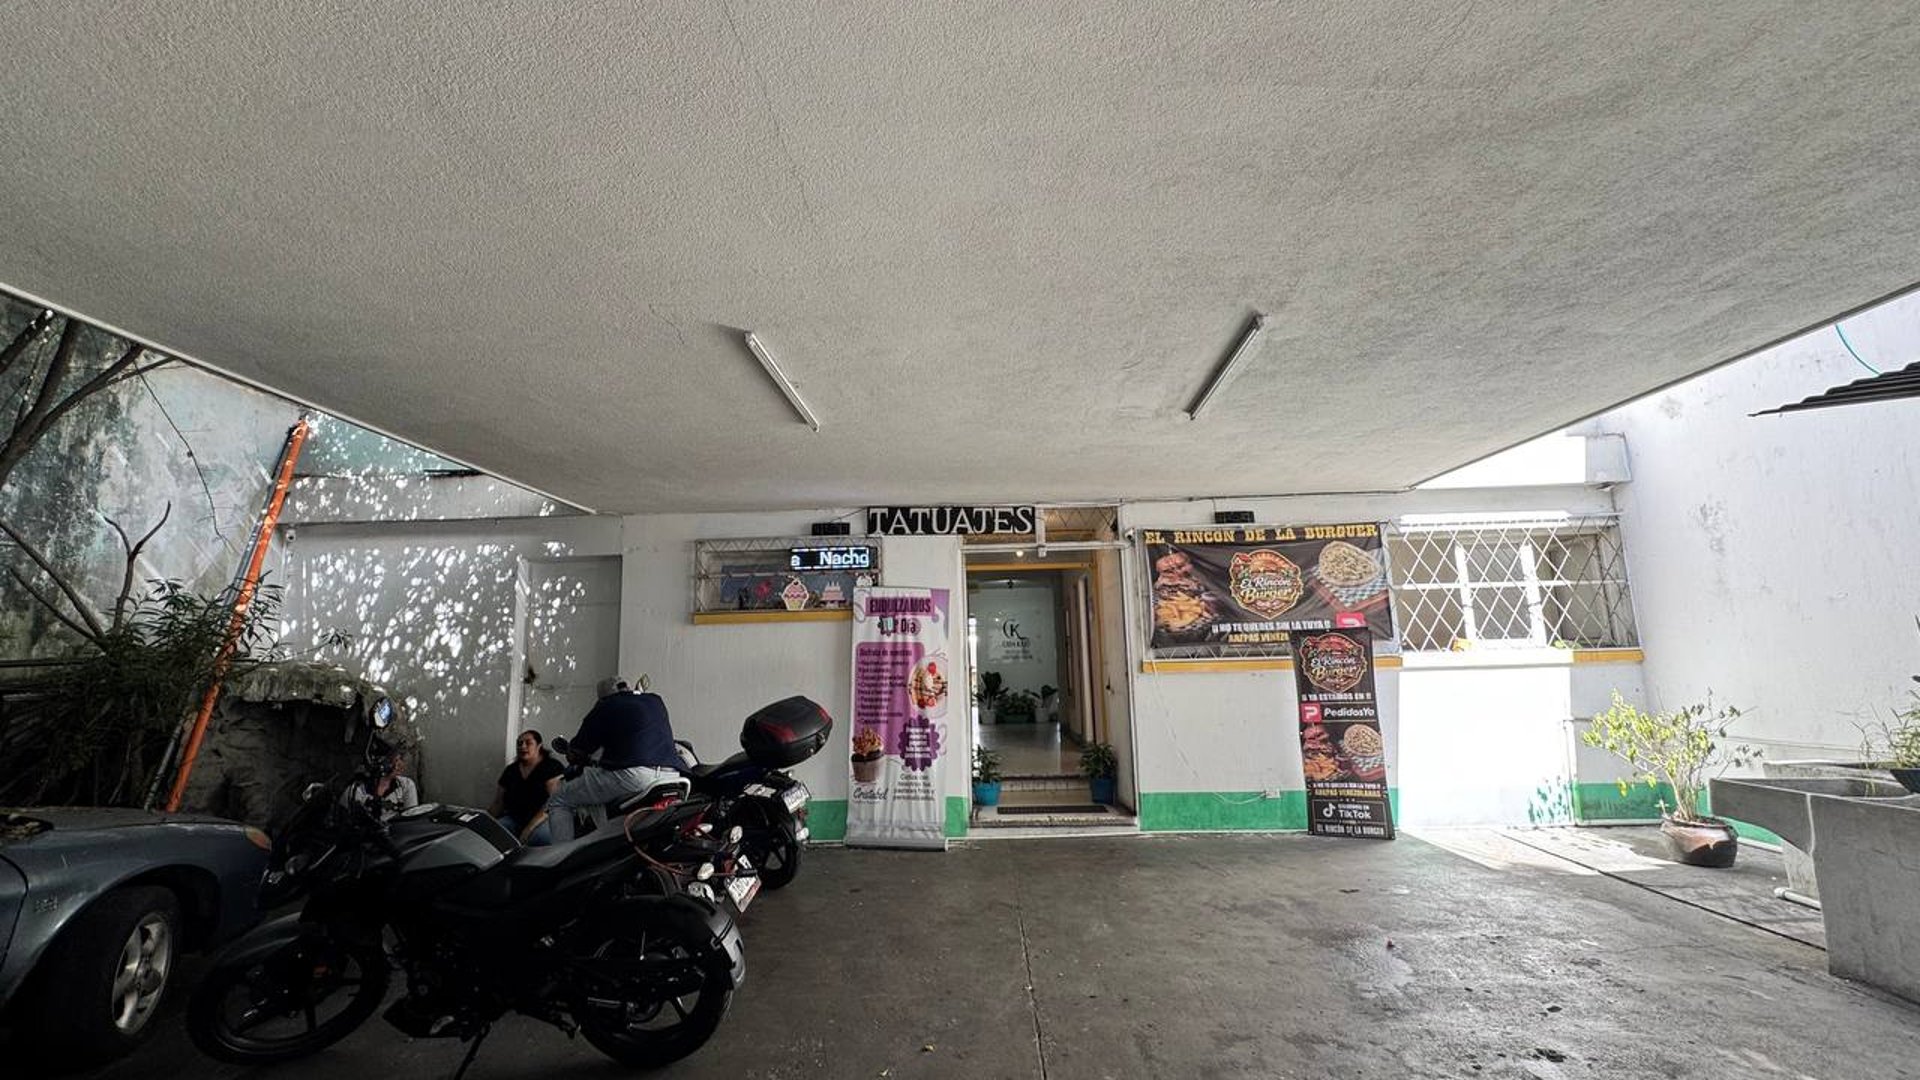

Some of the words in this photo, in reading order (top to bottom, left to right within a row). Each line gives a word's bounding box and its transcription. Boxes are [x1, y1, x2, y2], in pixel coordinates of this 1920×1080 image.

[869, 507, 1033, 534] TATUAJES
[1145, 531, 1165, 543] EL
[1245, 528, 1266, 541] DE
[1275, 527, 1296, 540] LA
[1304, 524, 1378, 539] BURGUER
[1240, 587, 1293, 603] Burger
[1324, 707, 1374, 717] PedidosYa
[1339, 810, 1371, 819] TikTok
